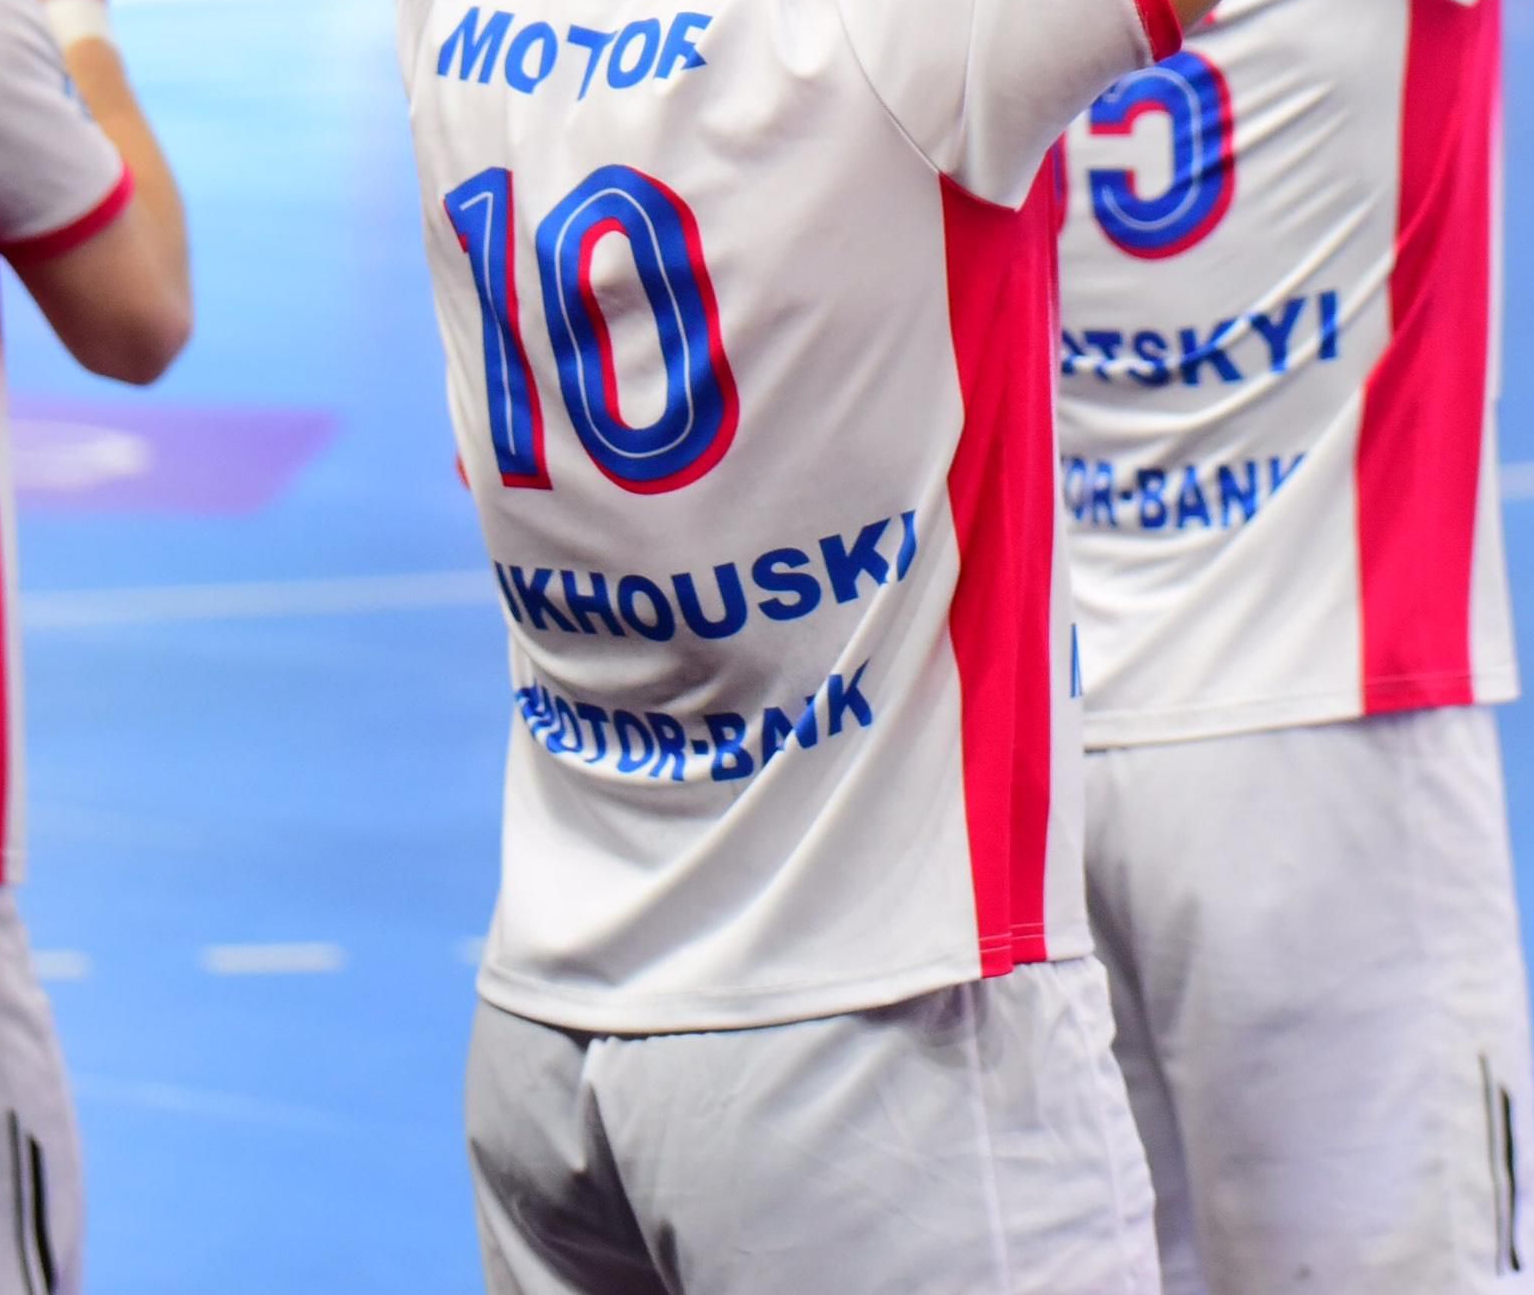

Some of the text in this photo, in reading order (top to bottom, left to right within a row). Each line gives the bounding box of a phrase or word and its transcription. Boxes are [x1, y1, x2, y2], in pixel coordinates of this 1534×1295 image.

[437, 6, 713, 100] MOTOR
[1050, 48, 1237, 261] 5
[443, 163, 741, 496] 10
